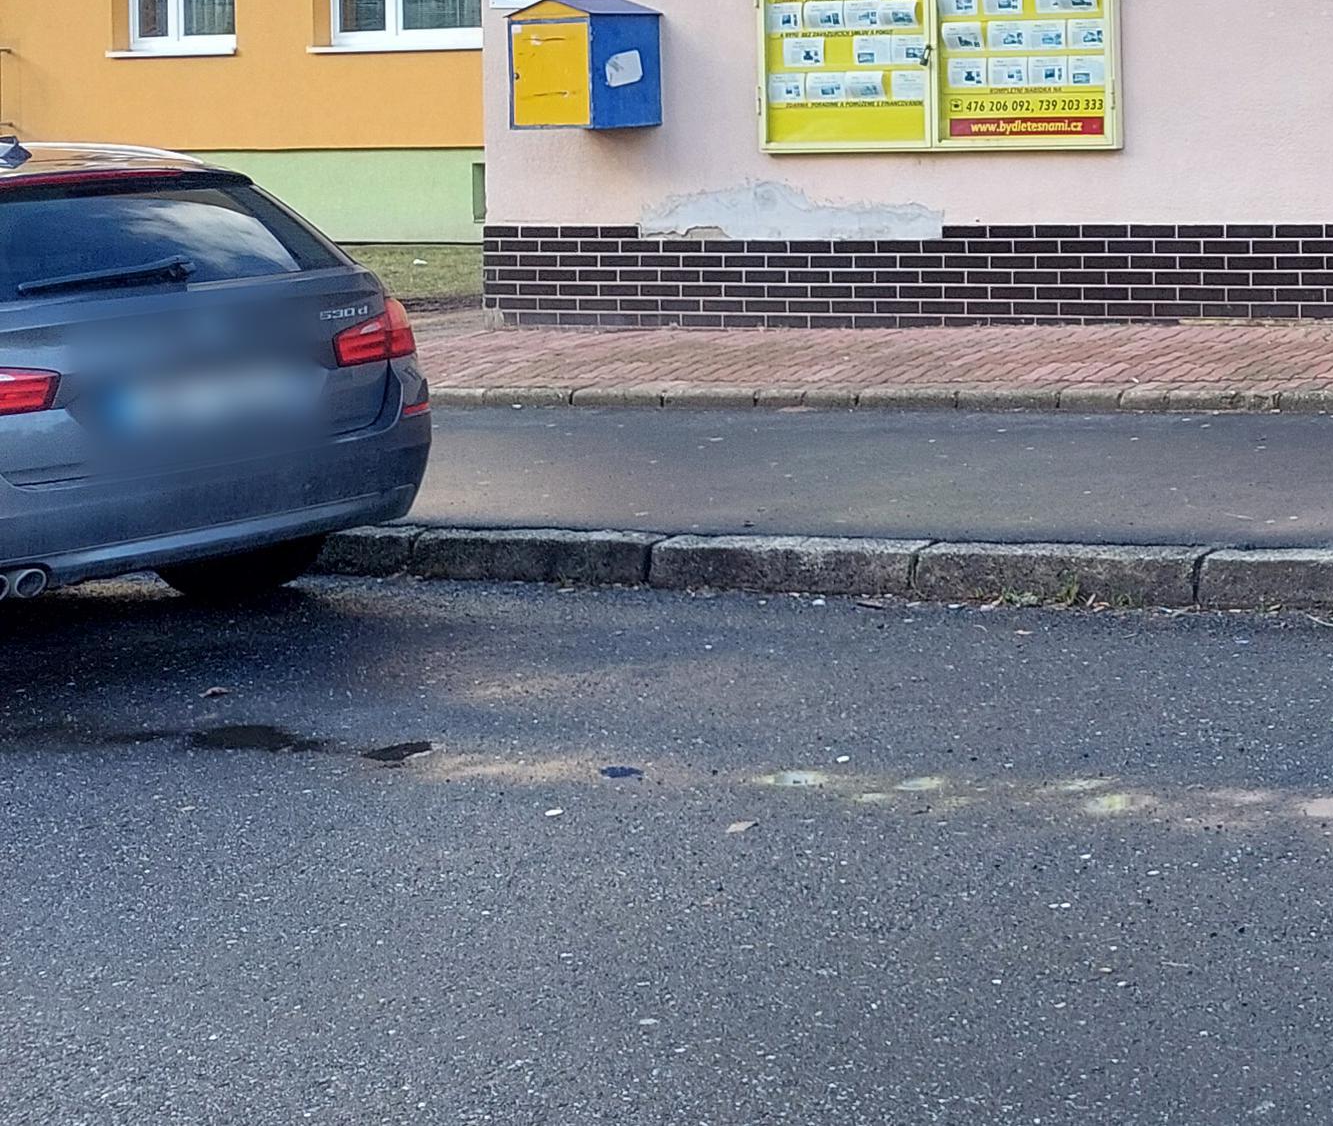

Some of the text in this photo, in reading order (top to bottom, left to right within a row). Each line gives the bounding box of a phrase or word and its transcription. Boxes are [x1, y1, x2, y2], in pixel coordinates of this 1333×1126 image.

[966, 99, 1104, 112] 476 206 092, 739 203 333
[970, 119, 1083, 134] www.bydletesnami.cz
